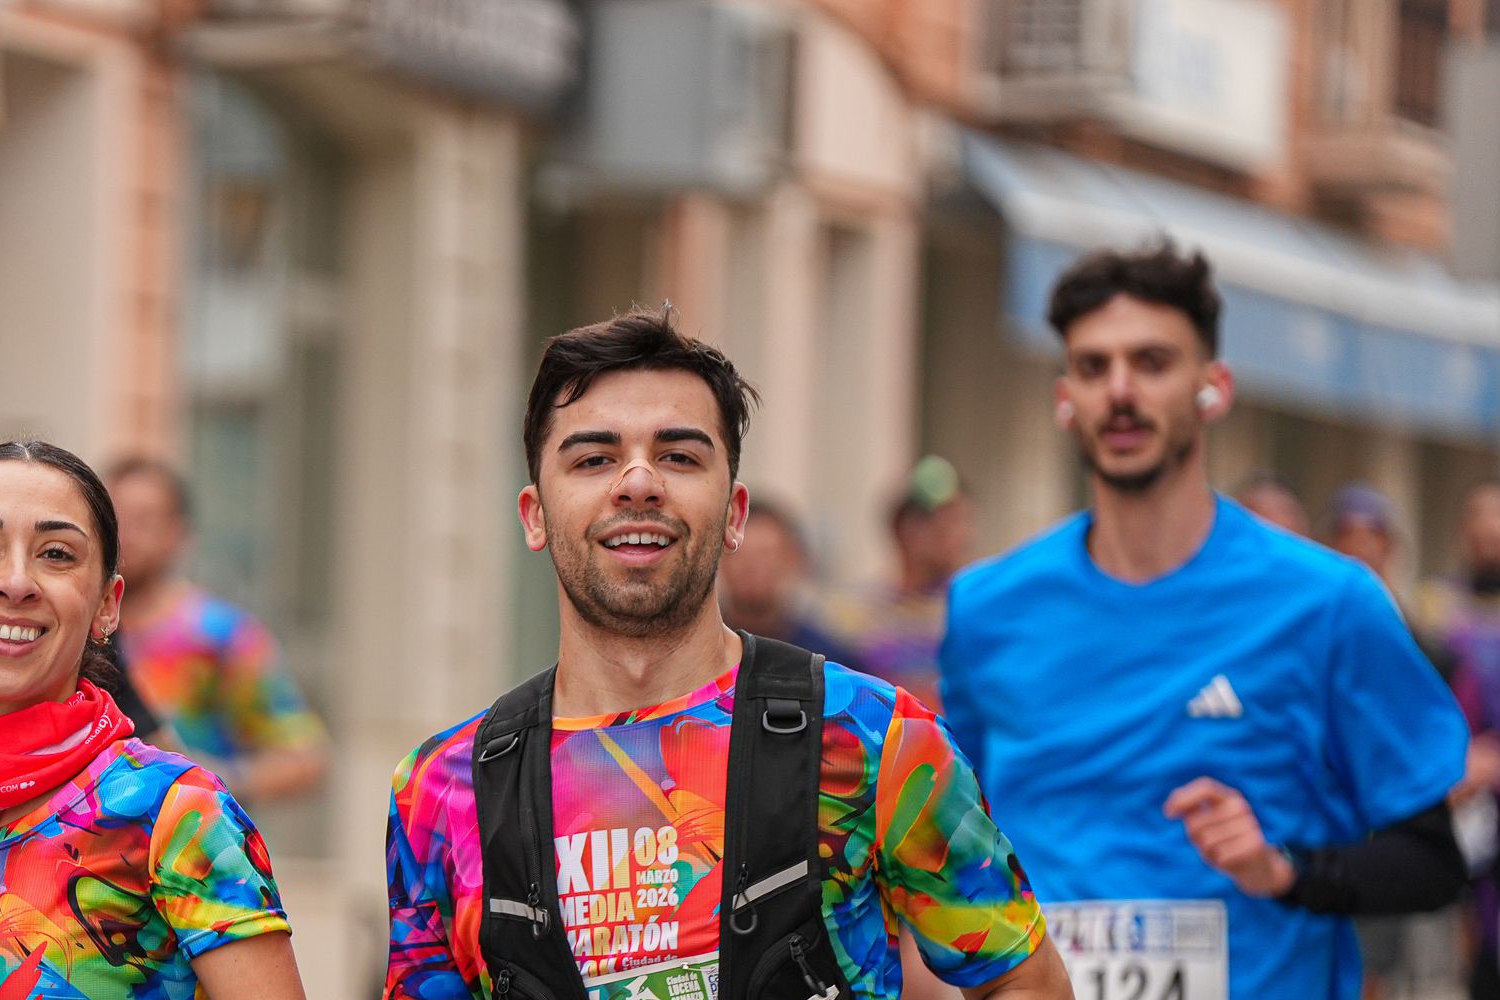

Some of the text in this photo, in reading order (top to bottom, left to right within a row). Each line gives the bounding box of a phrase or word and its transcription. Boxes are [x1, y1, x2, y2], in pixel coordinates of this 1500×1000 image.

[633, 825, 679, 867] 08
[554, 827, 631, 895] XII
[635, 868, 679, 886] MARZO
[636, 887, 679, 908] 2026
[558, 891, 635, 928] MEDIA
[622, 954, 661, 968] Ciudad
[668, 980, 701, 997] LUCENA
